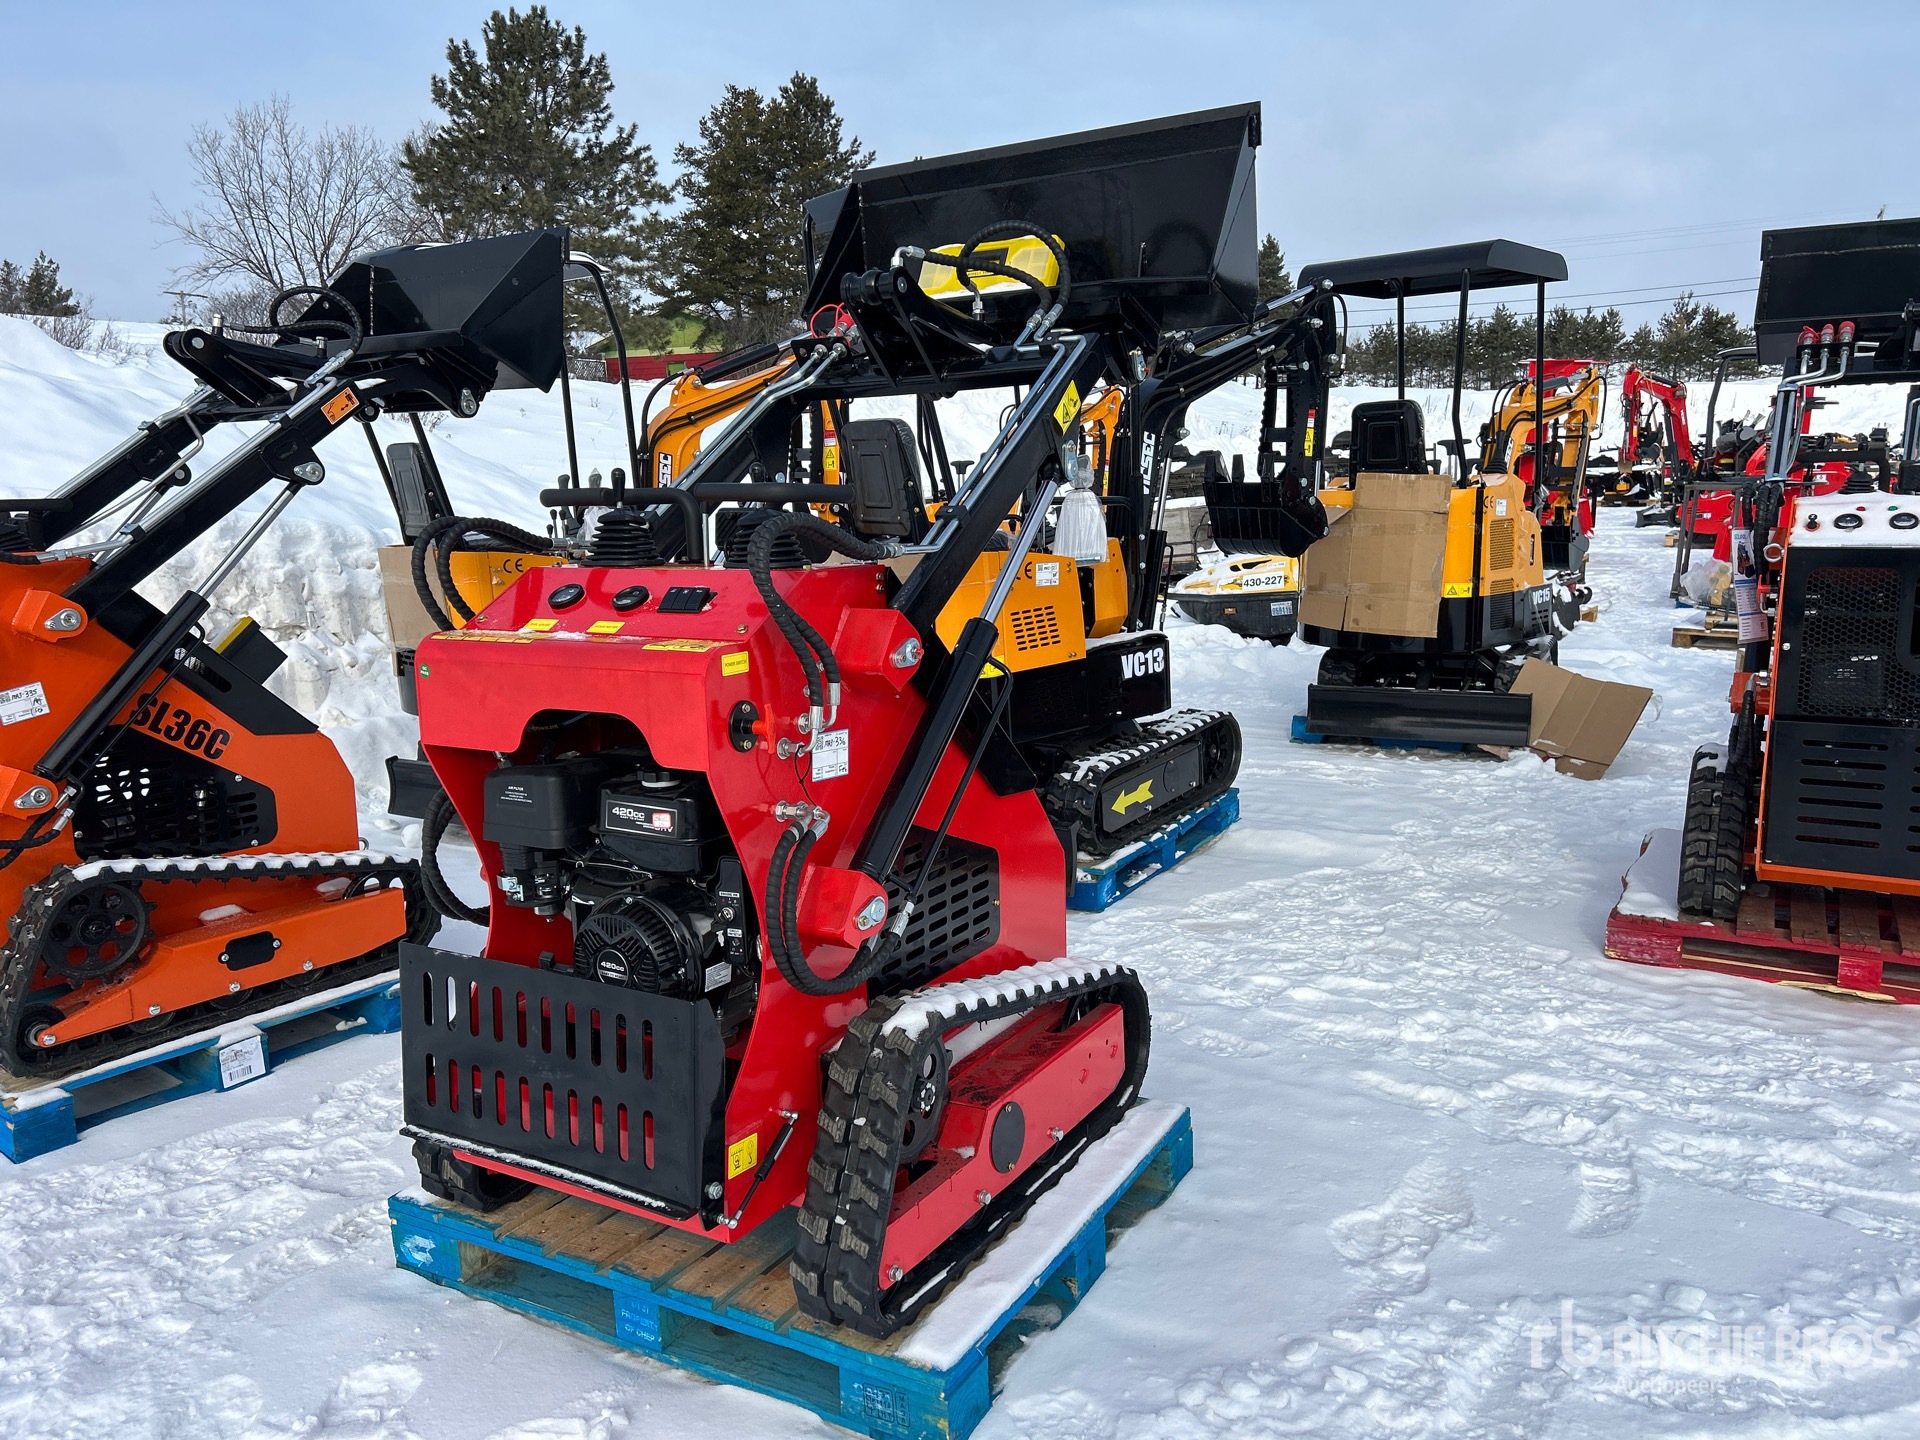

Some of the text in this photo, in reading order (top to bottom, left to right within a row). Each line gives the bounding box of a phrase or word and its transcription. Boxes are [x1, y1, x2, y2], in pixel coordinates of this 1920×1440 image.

[1243, 575, 1283, 588] 430-227
[1533, 587, 1551, 605] VC15
[1121, 647, 1165, 679] VC13
[129, 692, 231, 760] SL36C
[611, 806, 645, 819] 420cc
[600, 961, 625, 972] 420cc
